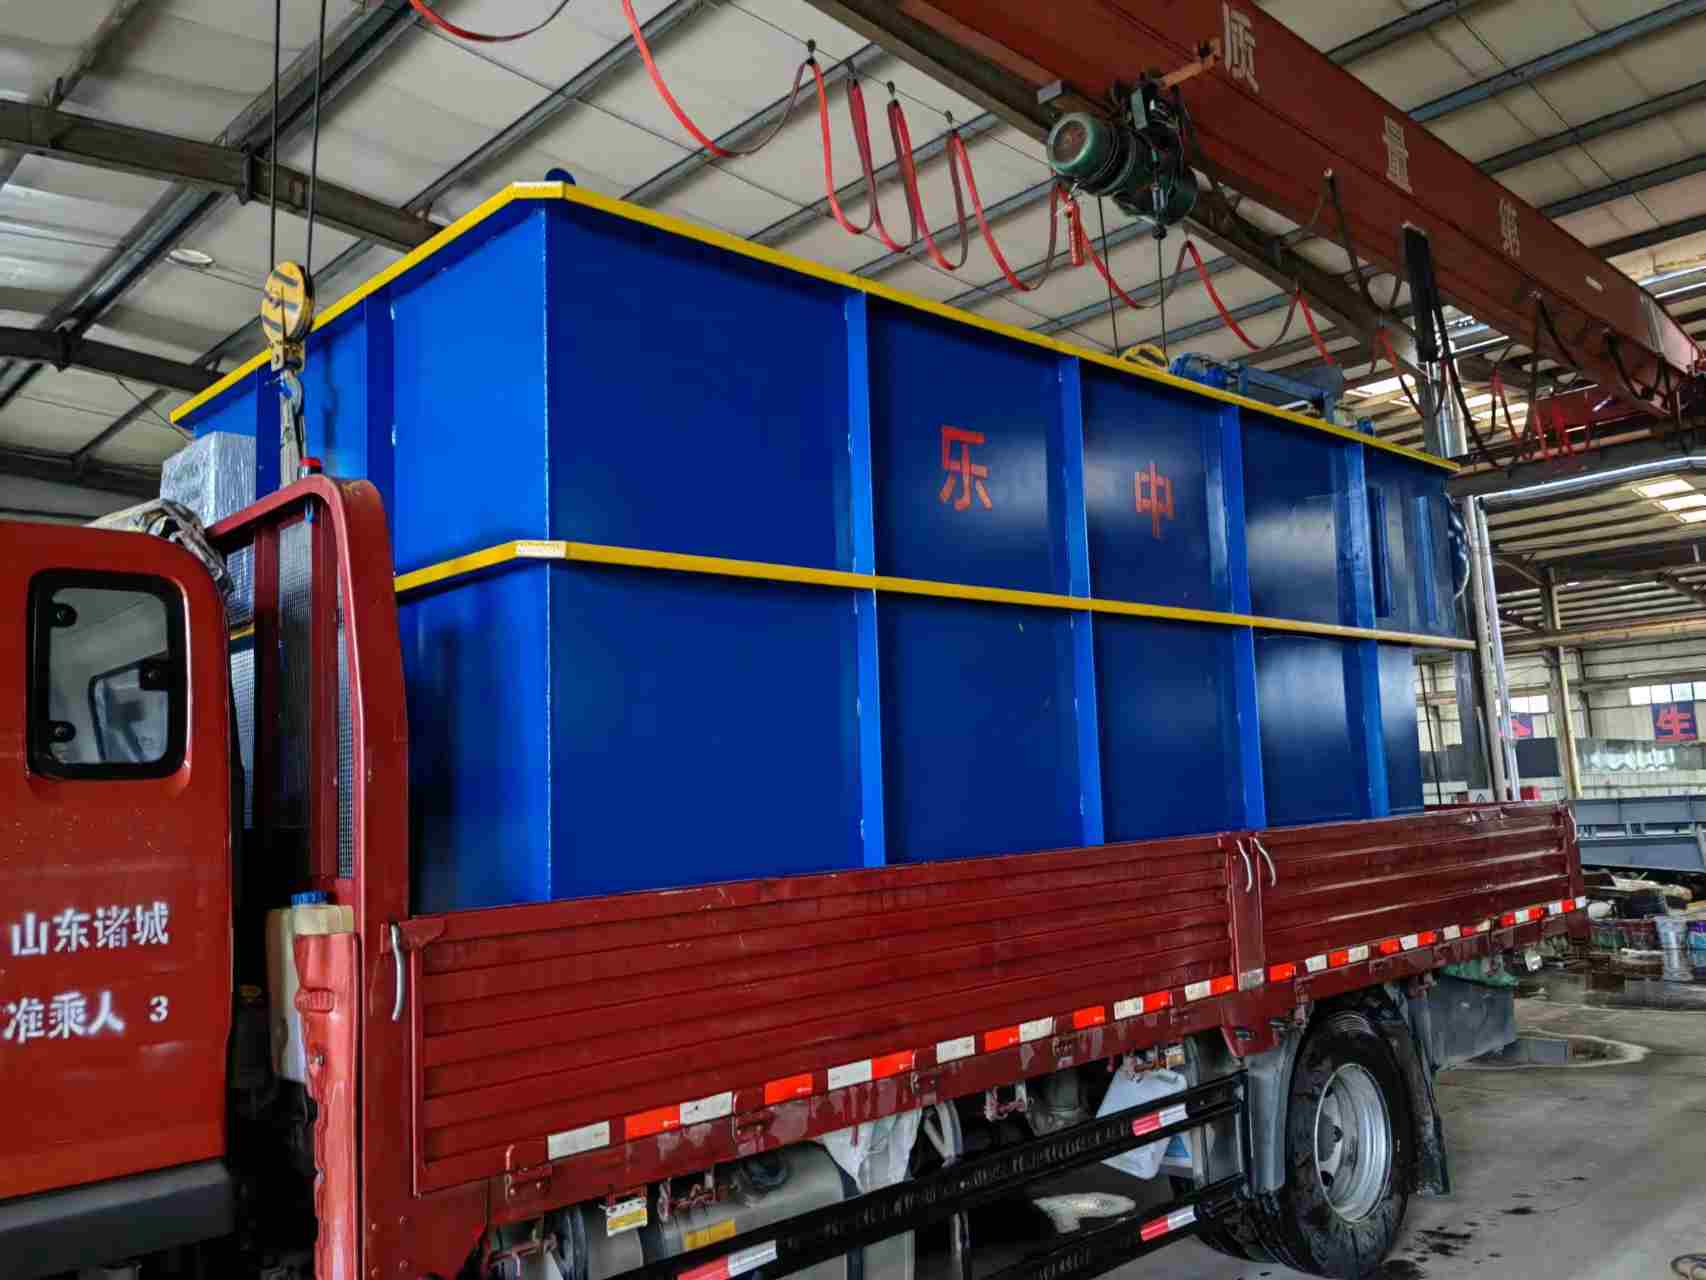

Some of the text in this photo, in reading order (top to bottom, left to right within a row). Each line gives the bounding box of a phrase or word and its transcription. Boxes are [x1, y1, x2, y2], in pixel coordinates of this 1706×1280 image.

[11, 901, 169, 956] 山东诸城
[3, 990, 169, 1044] 准乘人 3
